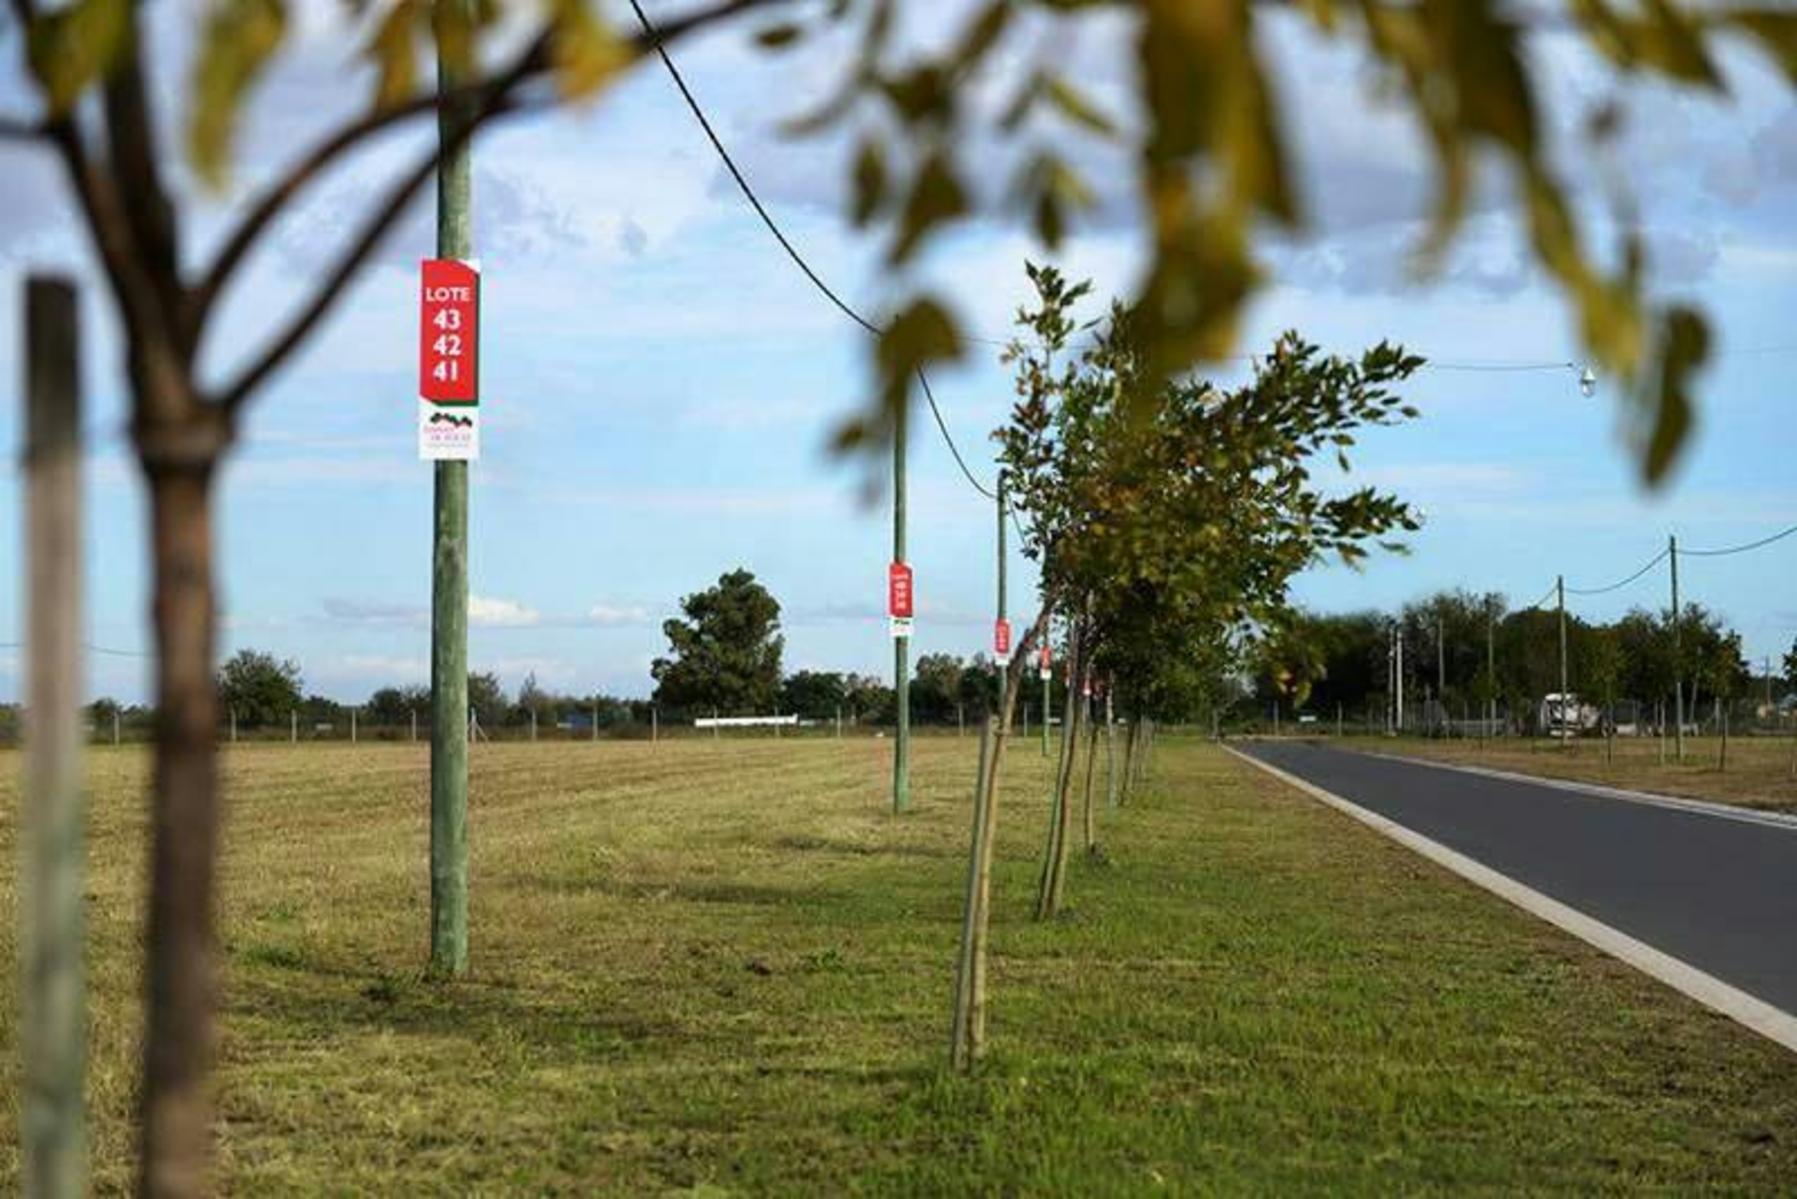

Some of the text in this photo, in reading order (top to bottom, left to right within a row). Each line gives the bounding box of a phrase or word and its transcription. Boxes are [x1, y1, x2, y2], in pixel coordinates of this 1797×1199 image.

[425, 287, 471, 302] LOTE
[433, 308, 462, 330] 43
[433, 334, 462, 356] 42
[433, 360, 458, 382] 41
